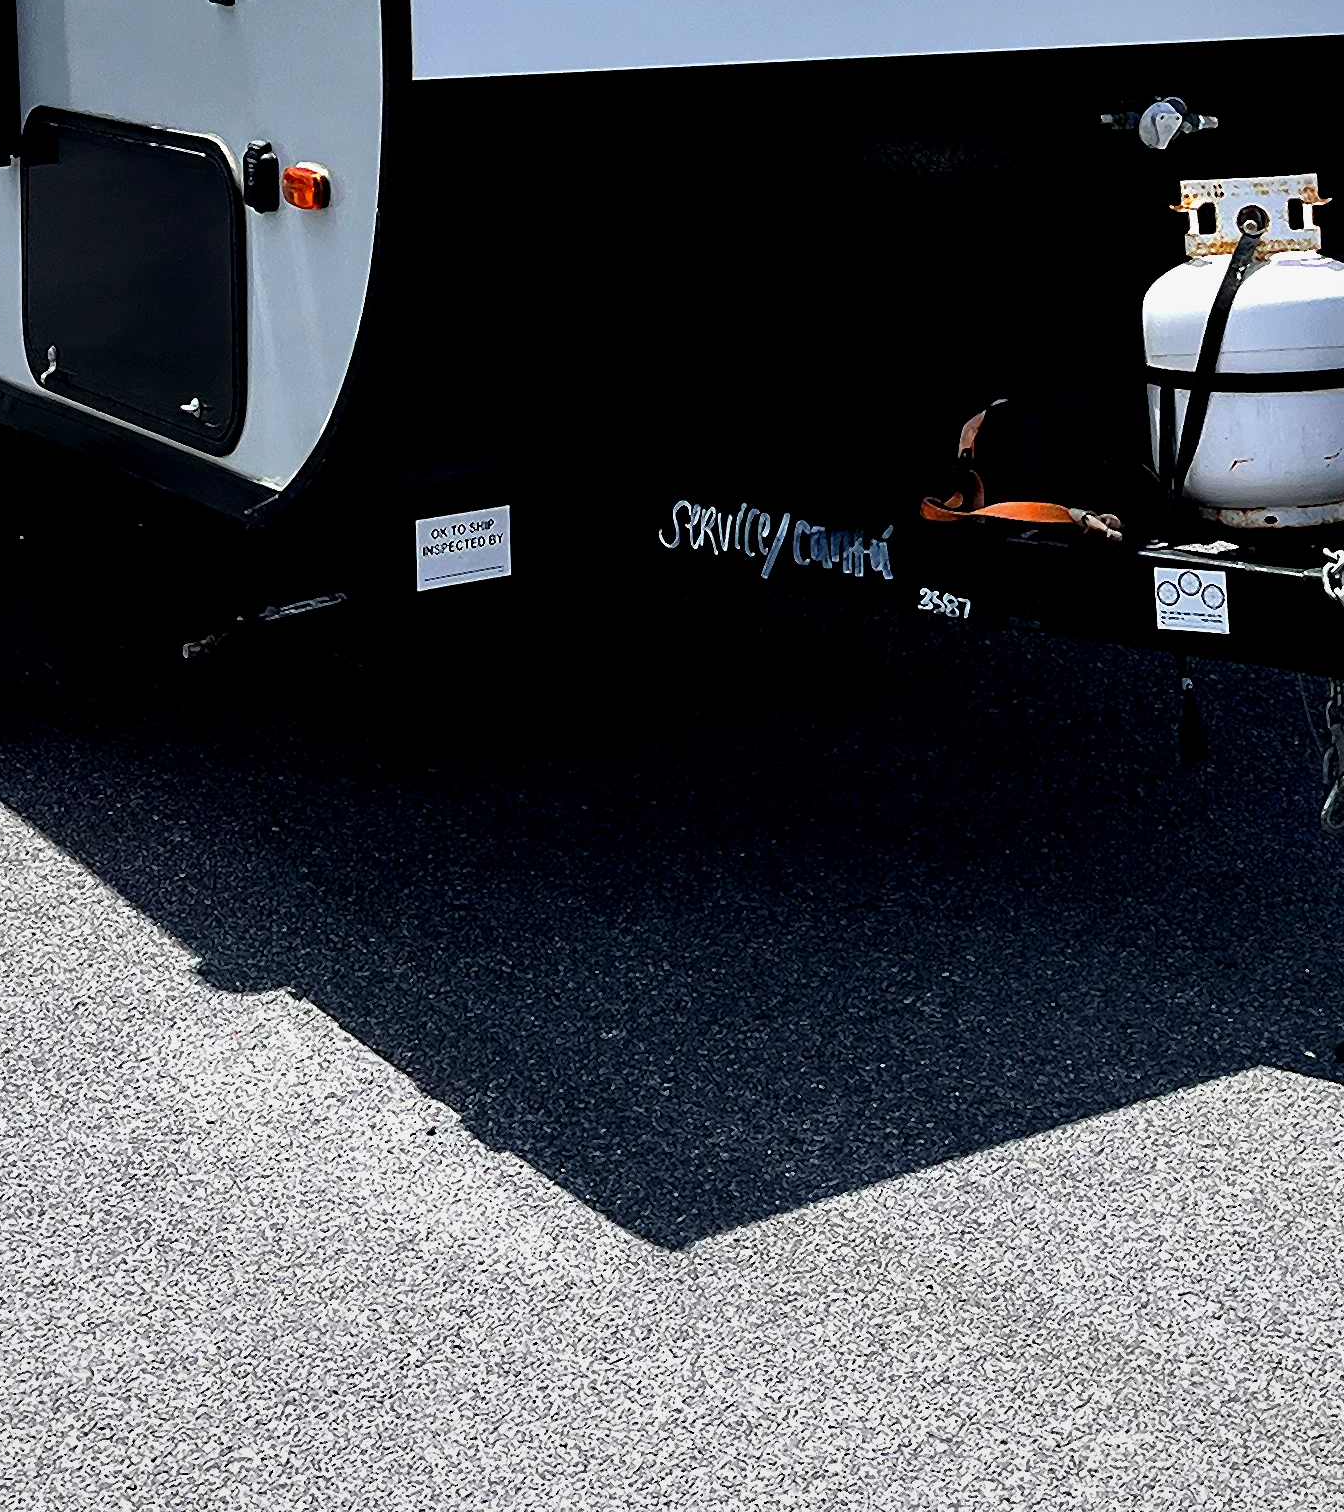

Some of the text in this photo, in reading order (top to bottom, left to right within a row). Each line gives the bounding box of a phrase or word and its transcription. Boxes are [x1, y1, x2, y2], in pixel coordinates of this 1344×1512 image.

[430, 518, 495, 540] OK TO SHIP
[422, 532, 504, 557] INSPECTED BY
[917, 587, 971, 619] 3587
